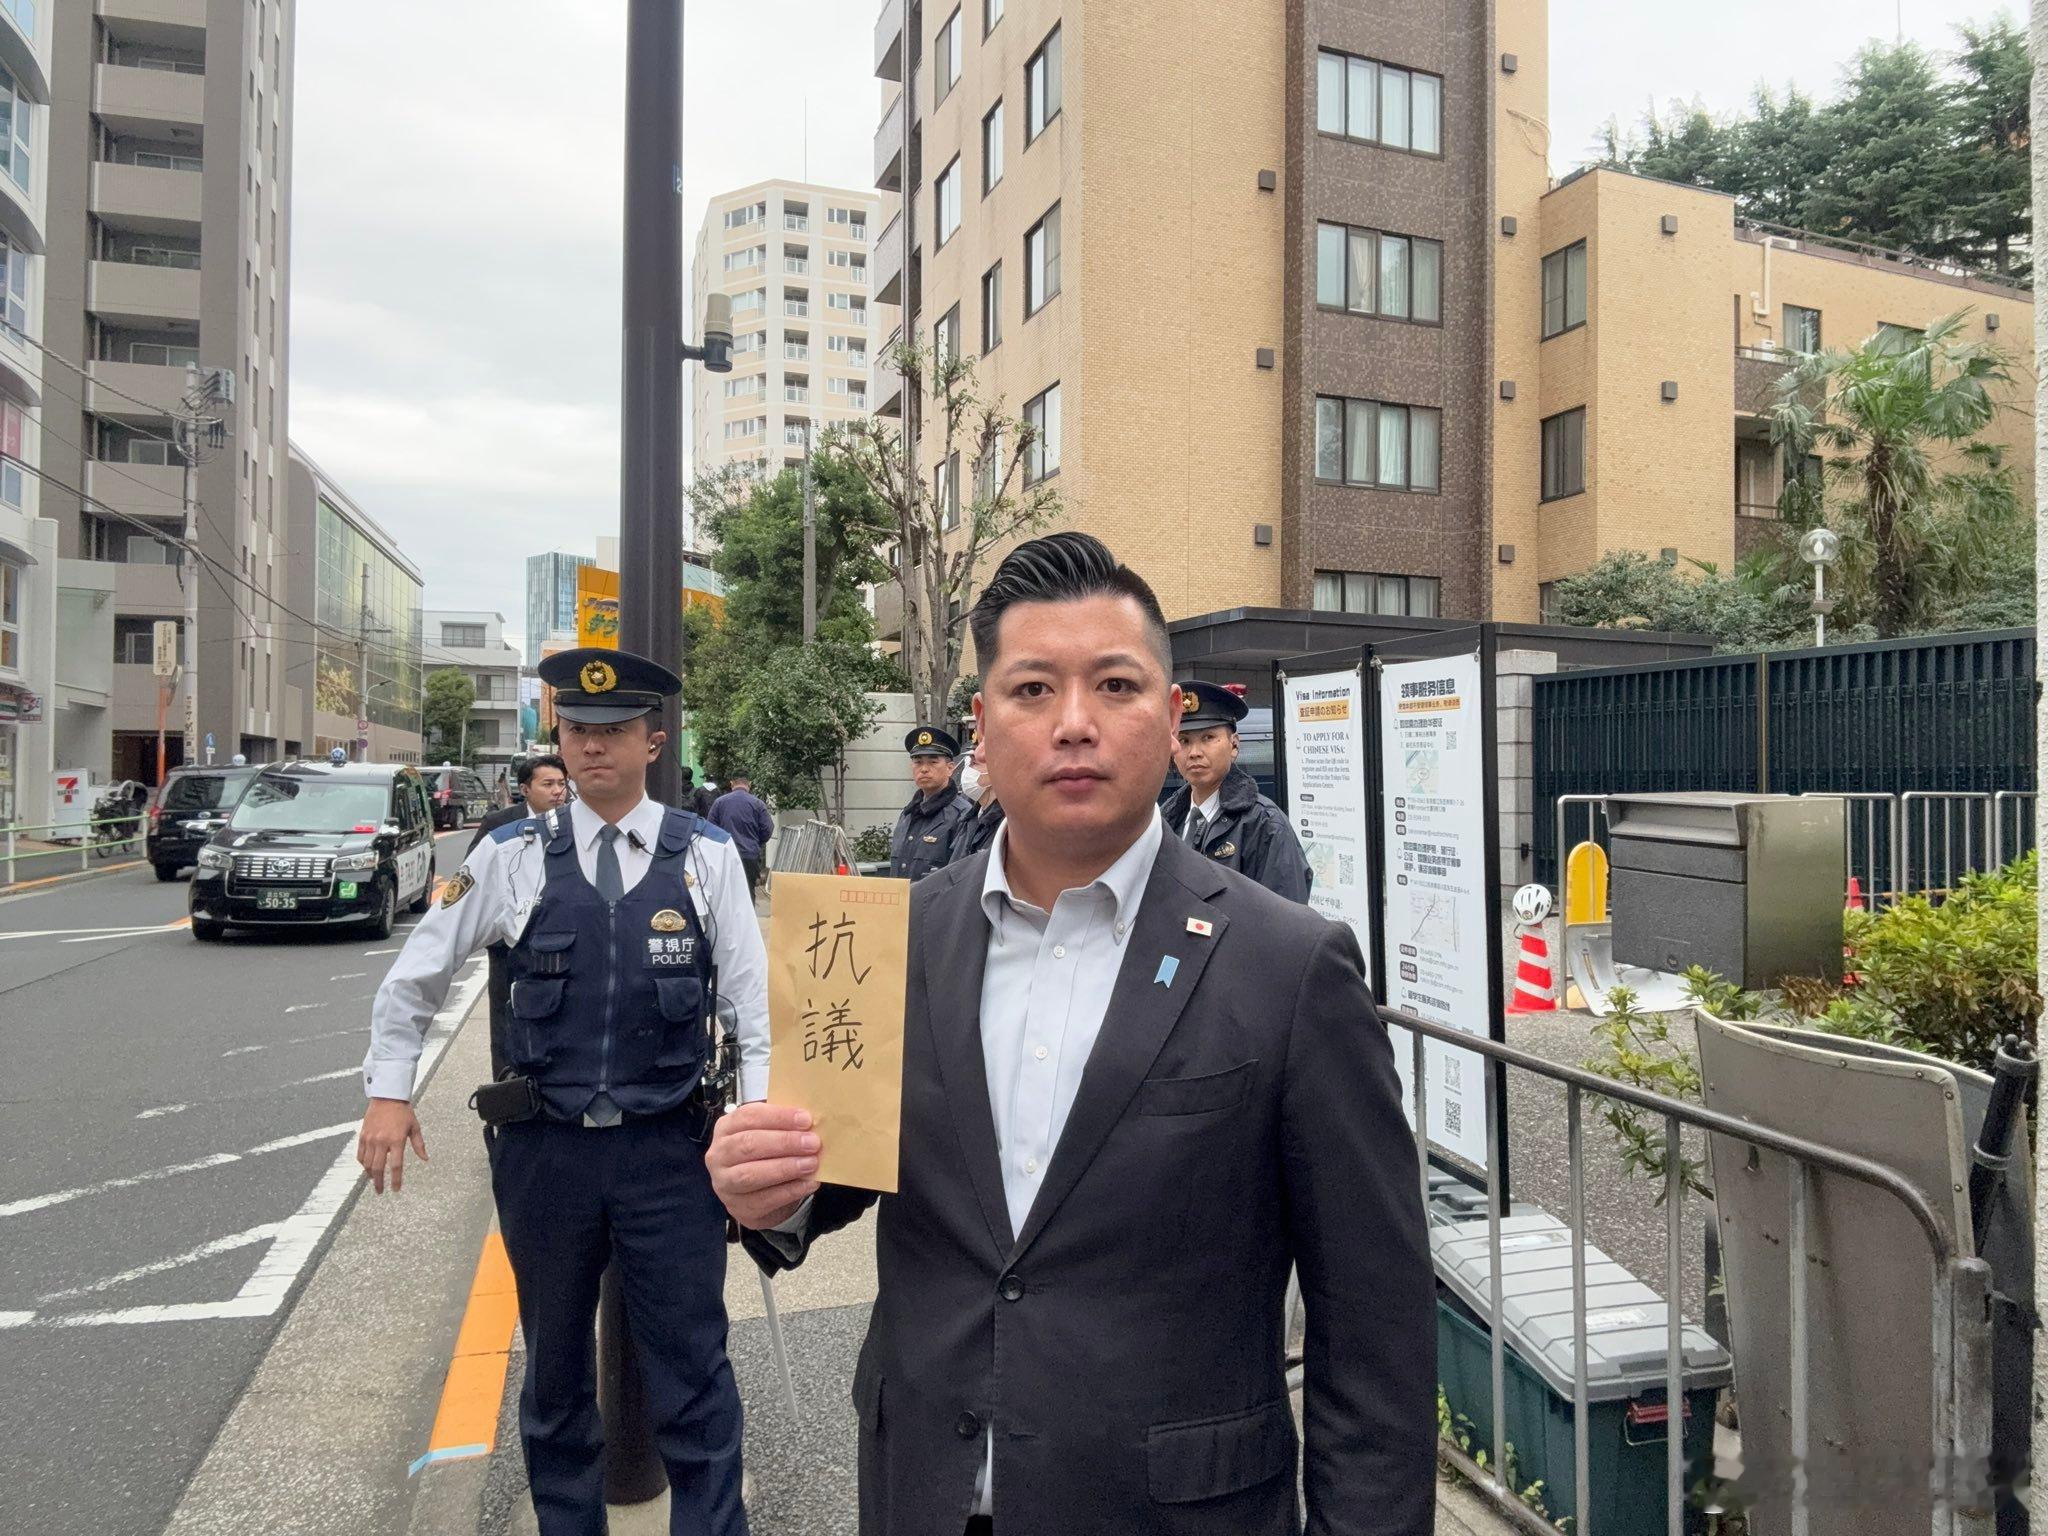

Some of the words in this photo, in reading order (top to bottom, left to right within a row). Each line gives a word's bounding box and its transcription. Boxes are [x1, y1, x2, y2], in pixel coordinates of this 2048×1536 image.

[1295, 690, 1310, 700] Visa
[1312, 686, 1351, 700] Information
[1303, 733, 1312, 742] TO
[1313, 732, 1330, 741] APPLY
[1331, 731, 1344, 741] FOR
[1345, 732, 1350, 740] A
[1303, 745, 1329, 754] CHINESE
[265, 897, 296, 909] 50-35
[647, 937, 695, 953] 警視庁
[652, 953, 693, 965] POLICE
[801, 911, 872, 1072] 抗議
